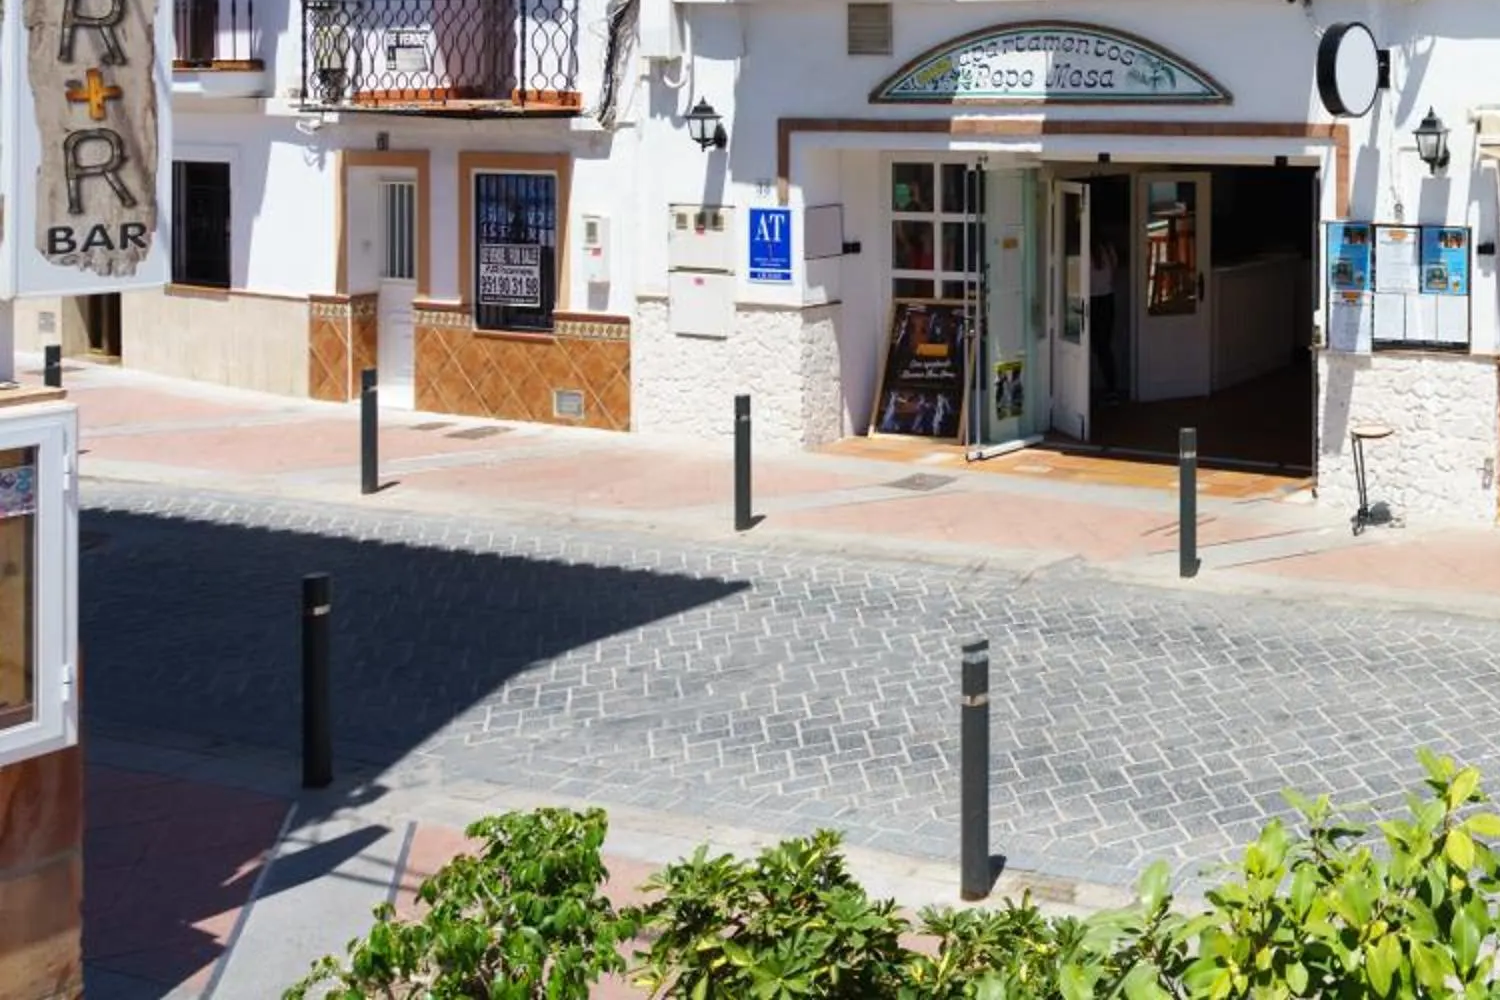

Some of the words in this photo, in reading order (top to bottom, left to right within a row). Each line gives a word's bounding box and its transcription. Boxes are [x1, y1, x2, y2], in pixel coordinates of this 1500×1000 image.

[974, 63, 1034, 90] Pepe
[1045, 63, 1115, 89] Mesa
[47, 222, 148, 255] BAR
[754, 213, 785, 243] AT
